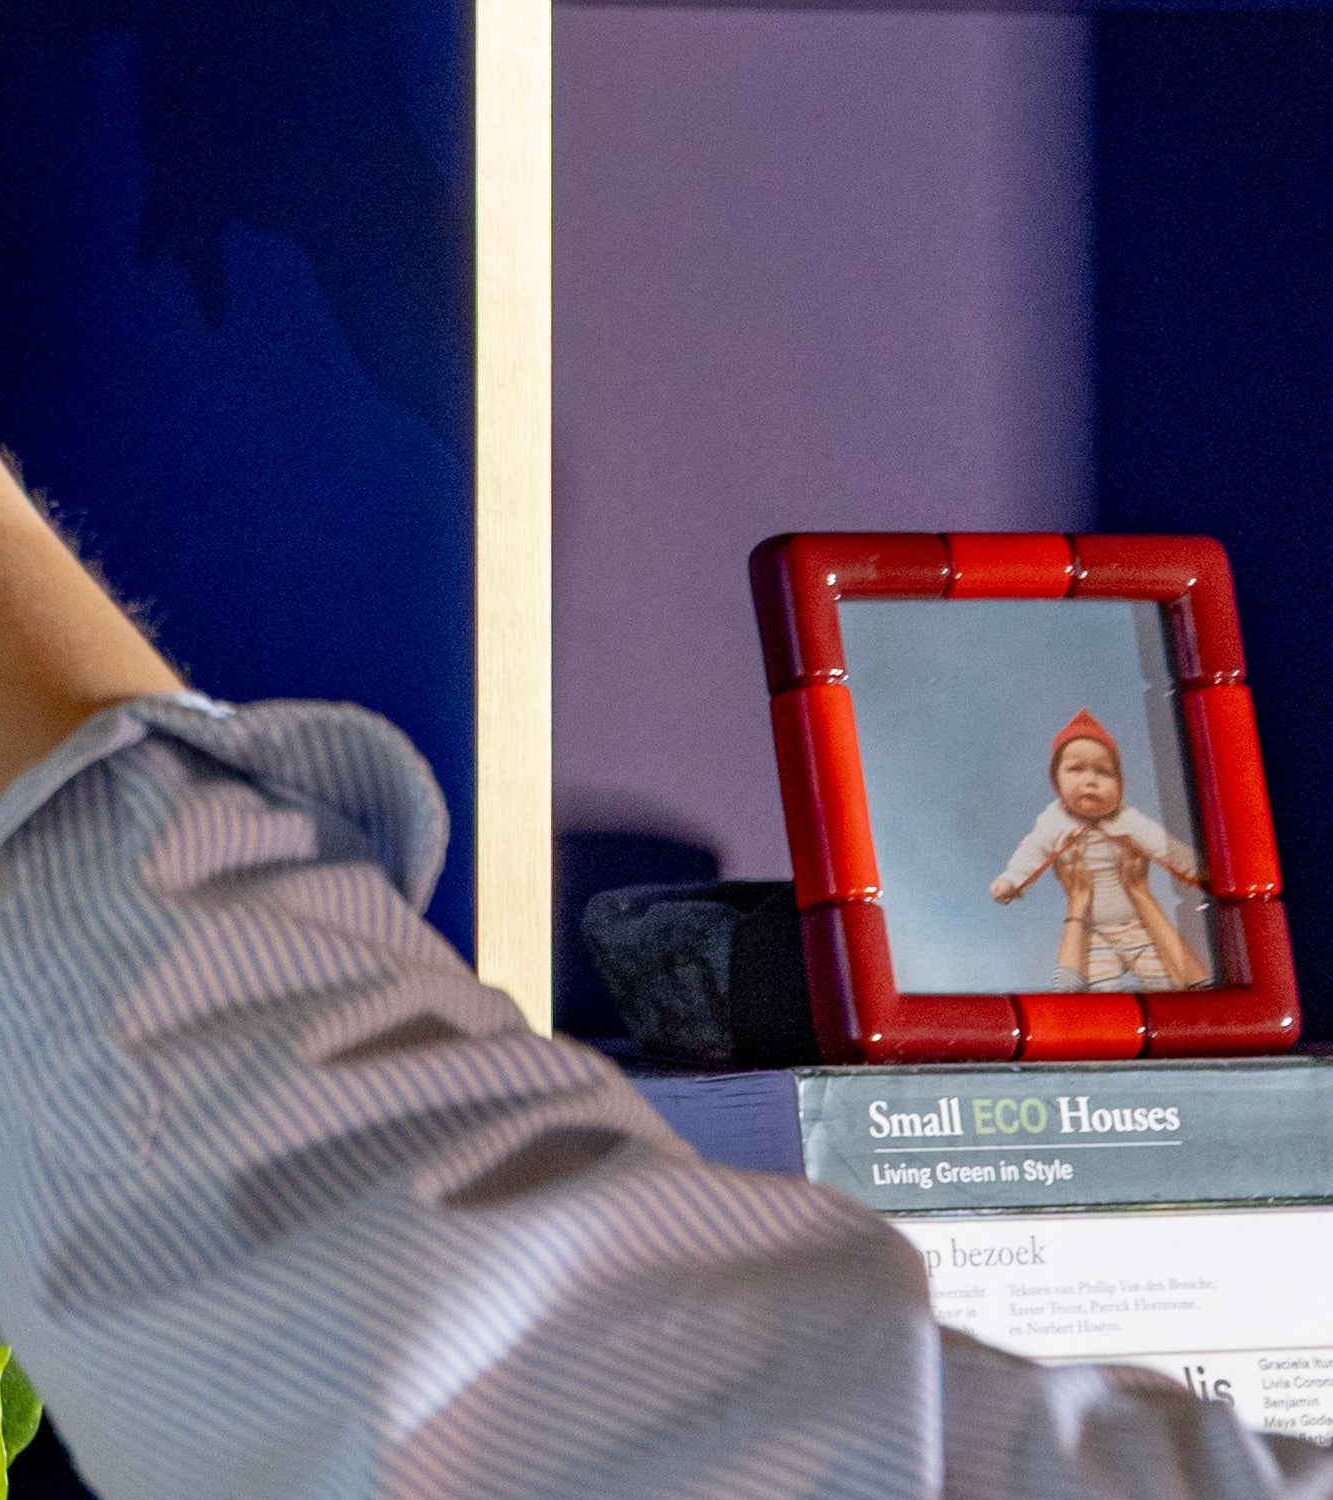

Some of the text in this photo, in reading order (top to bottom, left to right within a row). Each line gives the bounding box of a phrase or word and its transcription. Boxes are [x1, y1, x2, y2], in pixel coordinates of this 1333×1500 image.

[868, 1096, 1181, 1139] Small ECO Houses
[872, 1158, 1074, 1190] Living Green in Style
[925, 1235, 1047, 1278] p bezoek
[1263, 1395, 1319, 1411] Benjamin
